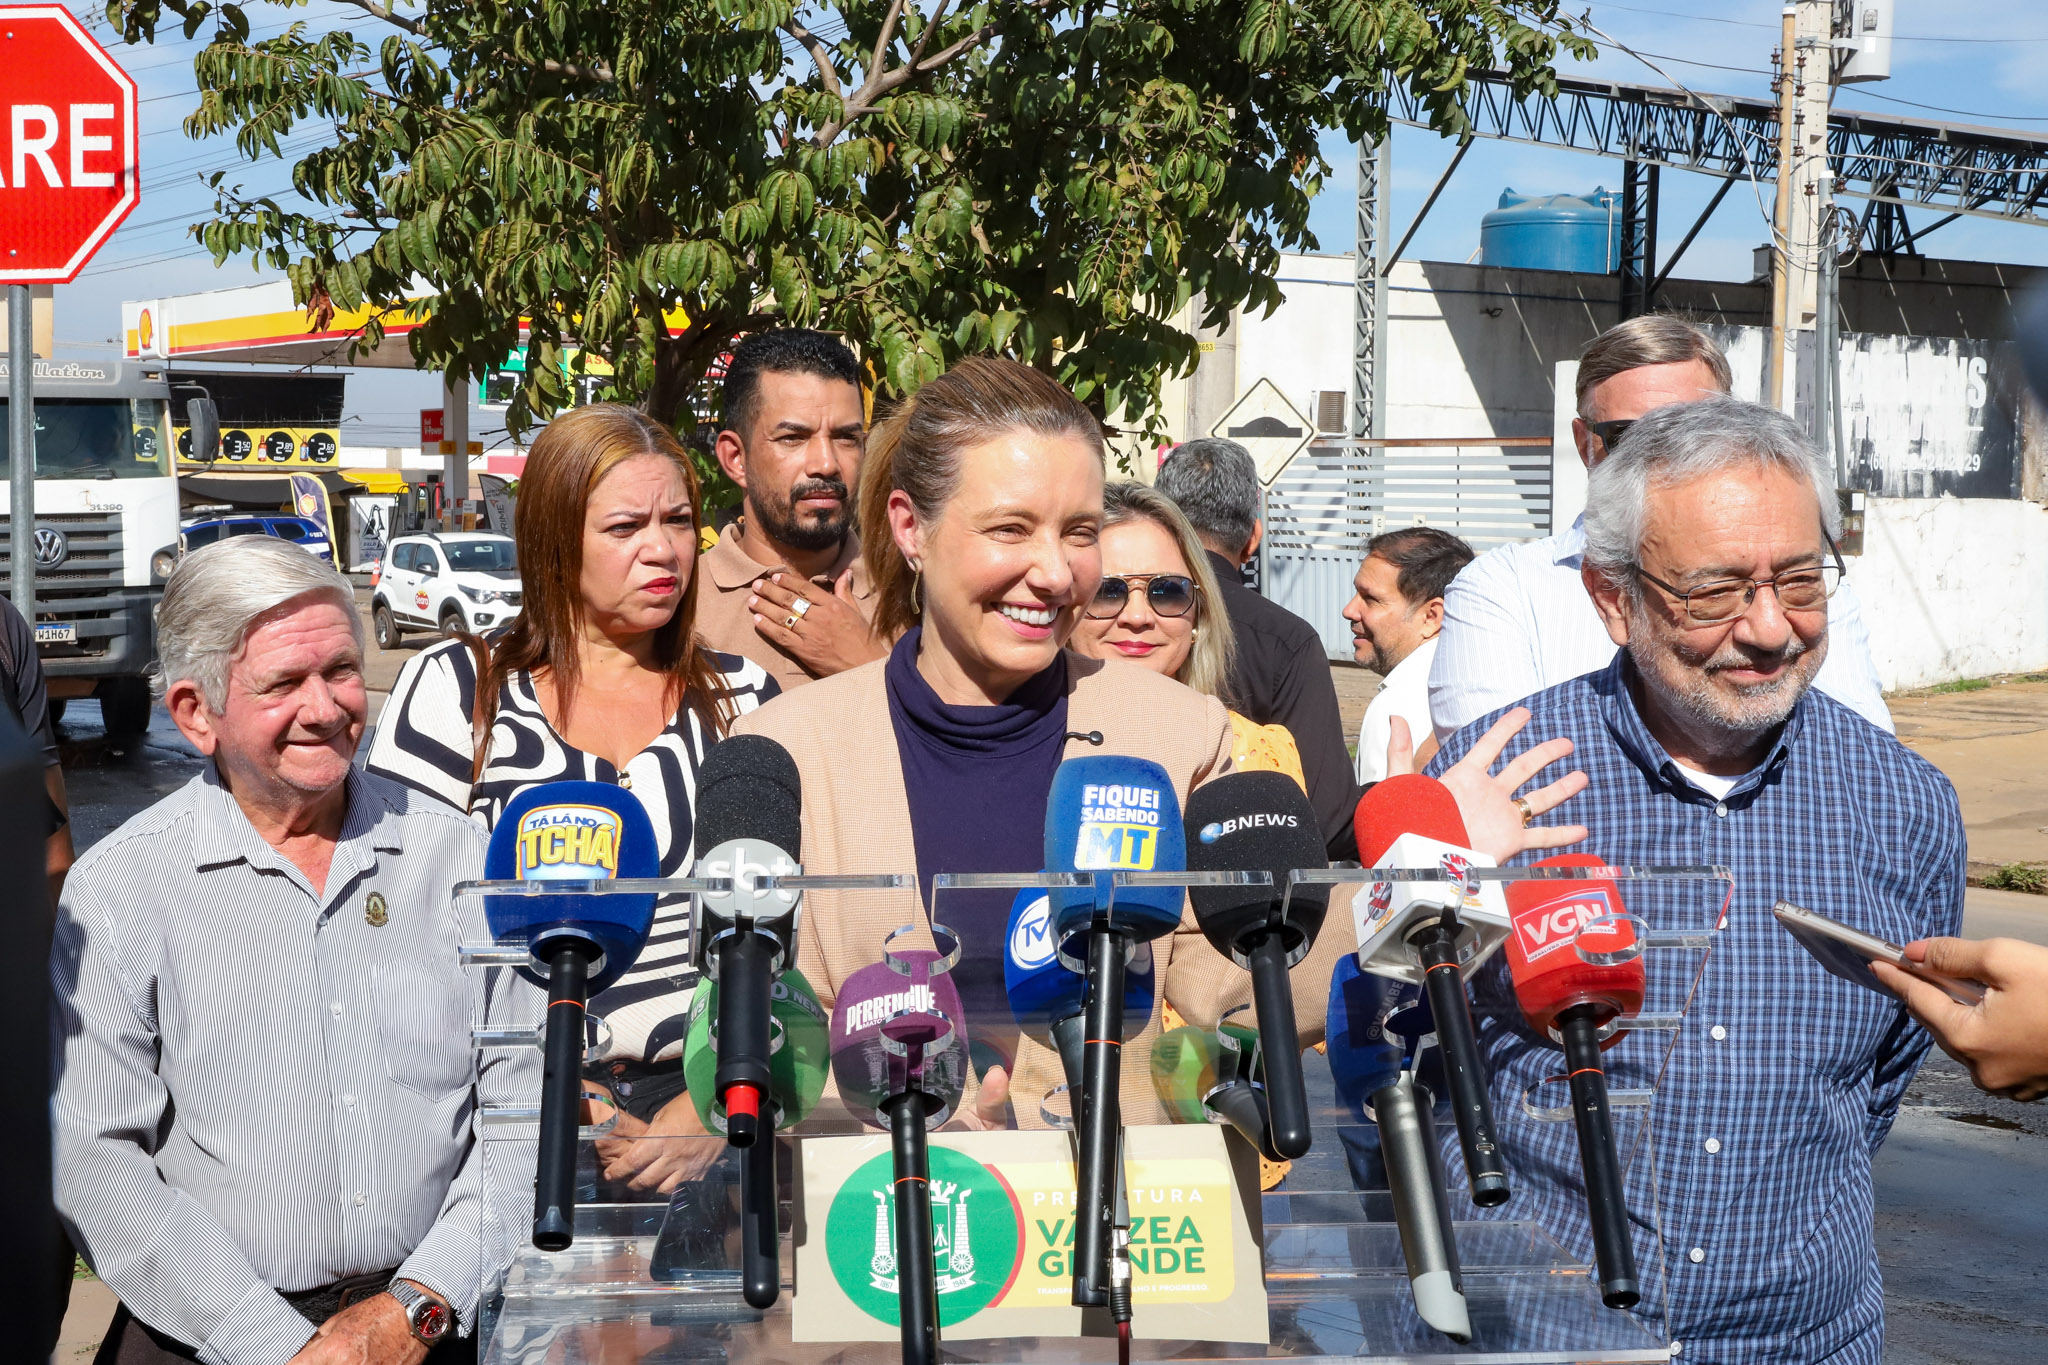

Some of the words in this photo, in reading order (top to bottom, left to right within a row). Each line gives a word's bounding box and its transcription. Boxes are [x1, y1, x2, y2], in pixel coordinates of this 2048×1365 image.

[0, 103, 115, 188] RE
[33, 362, 106, 379] llation
[496, 504, 508, 532] RIME
[530, 815, 549, 829] TÁ
[552, 813, 572, 825] LÁ
[575, 816, 597, 828] NO
[1082, 807, 1159, 825] SABENDO
[521, 823, 615, 870] TCHÁ
[1086, 827, 1150, 865] MT
[707, 847, 793, 903] sbt
[1522, 903, 1604, 945] VGN
[1366, 981, 1406, 1040] @VEJABE
[1033, 1188, 1203, 1207] PRETURA
[1035, 1209, 1203, 1247] VÁZEA
[1037, 1247, 1206, 1277] GNDE
[952, 1277, 967, 1288] 1948
[1037, 1286, 1073, 1295] TRANSPA
